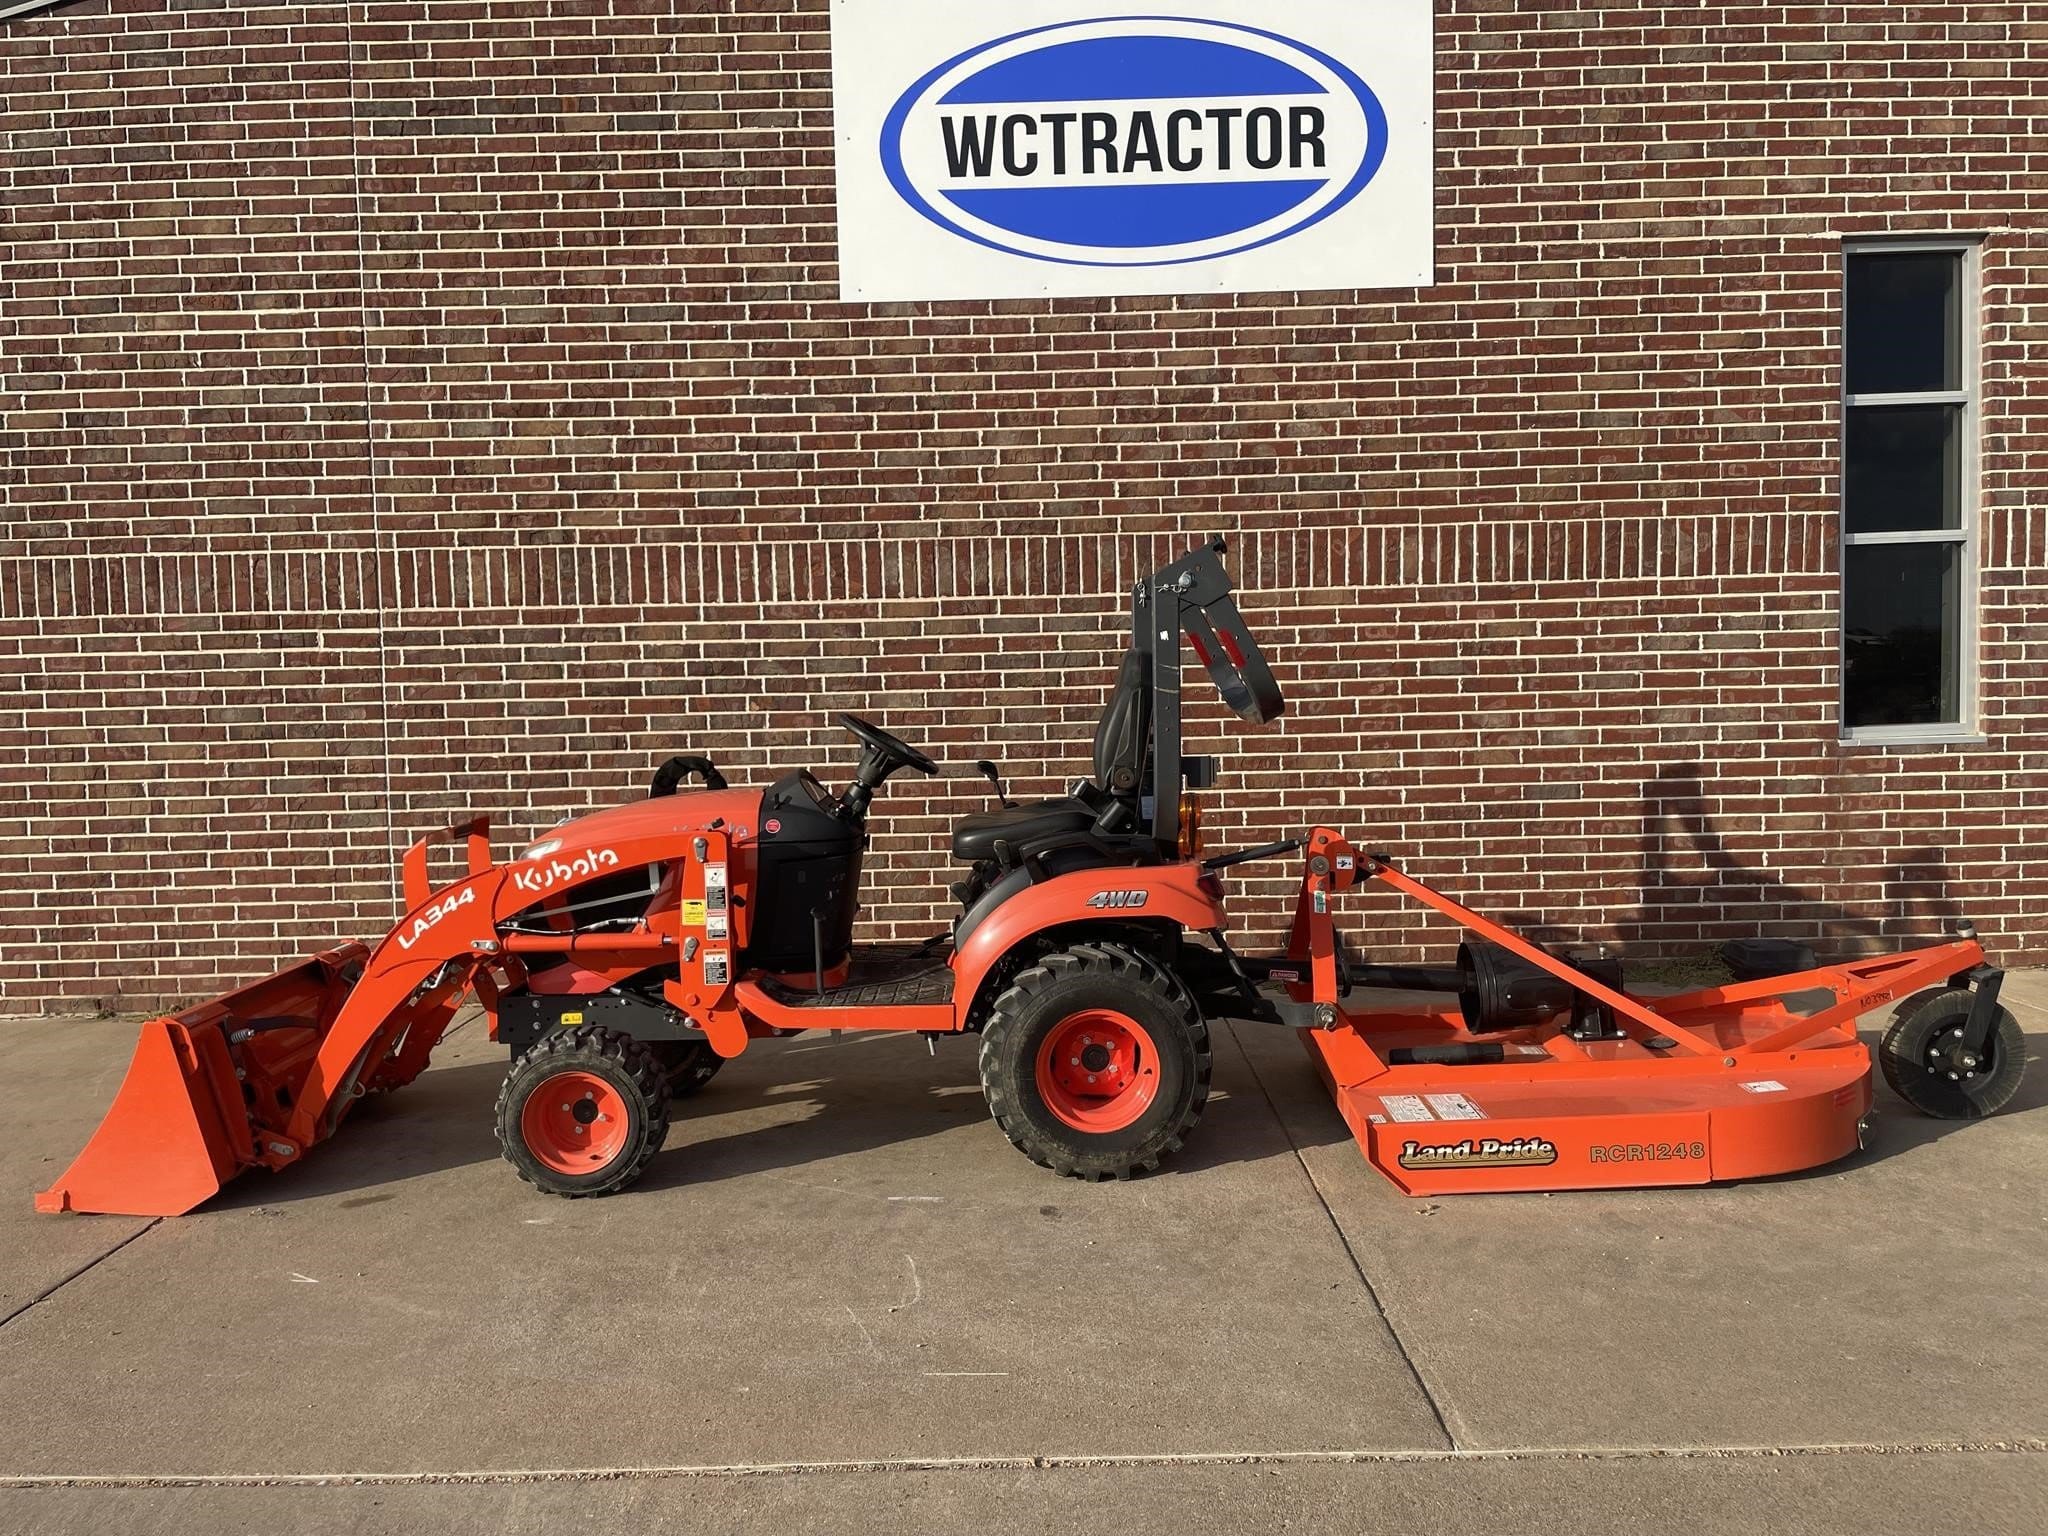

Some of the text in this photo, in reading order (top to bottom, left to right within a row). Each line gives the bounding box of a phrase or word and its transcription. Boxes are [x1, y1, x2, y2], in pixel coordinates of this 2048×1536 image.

[940, 106, 1326, 178] WCTRACTOR
[514, 848, 619, 892] Kubota
[1086, 890, 1149, 909] 4WD
[397, 887, 476, 950] LA344
[1402, 1137, 1553, 1162] Land Pride
[1590, 1142, 1705, 1163] RCR1248
